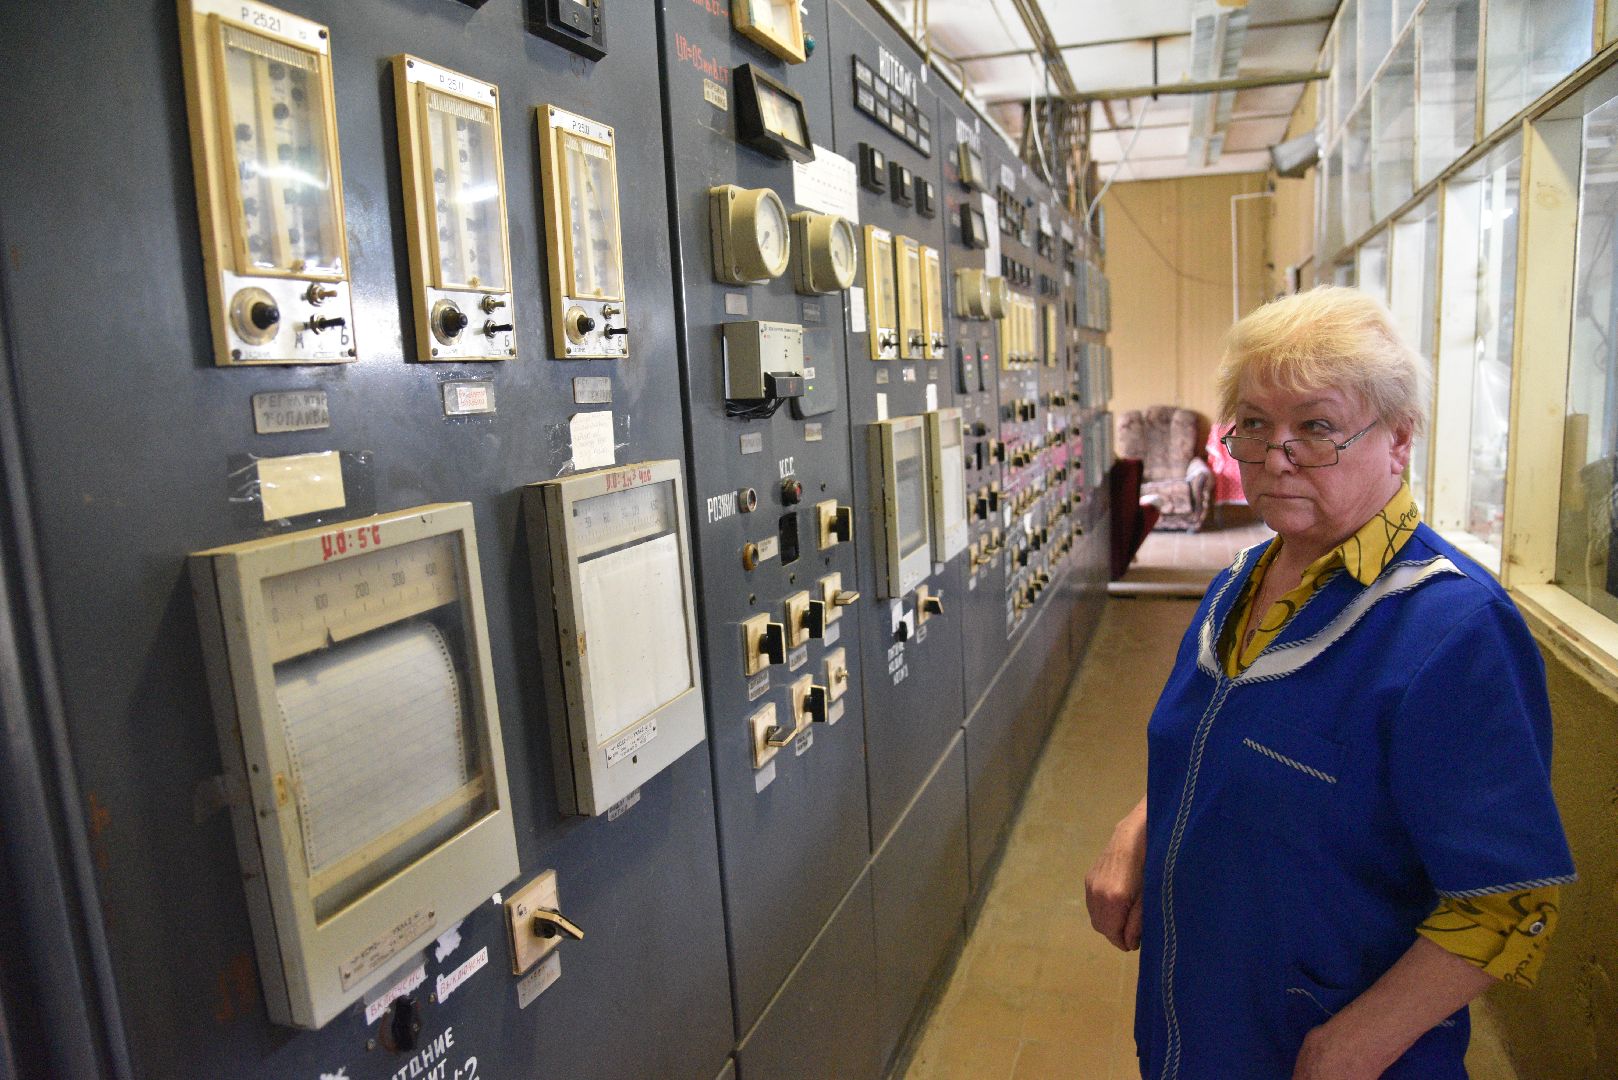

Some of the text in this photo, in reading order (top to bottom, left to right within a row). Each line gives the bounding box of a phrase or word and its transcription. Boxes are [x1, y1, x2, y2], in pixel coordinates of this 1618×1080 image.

[706, 490, 738, 524] РОЗЖИГ
[314, 593, 329, 610] 100
[354, 580, 370, 599] 200
[391, 570, 406, 587] 300
[439, 949, 487, 996] ВЫКЛЮЧЕНО
